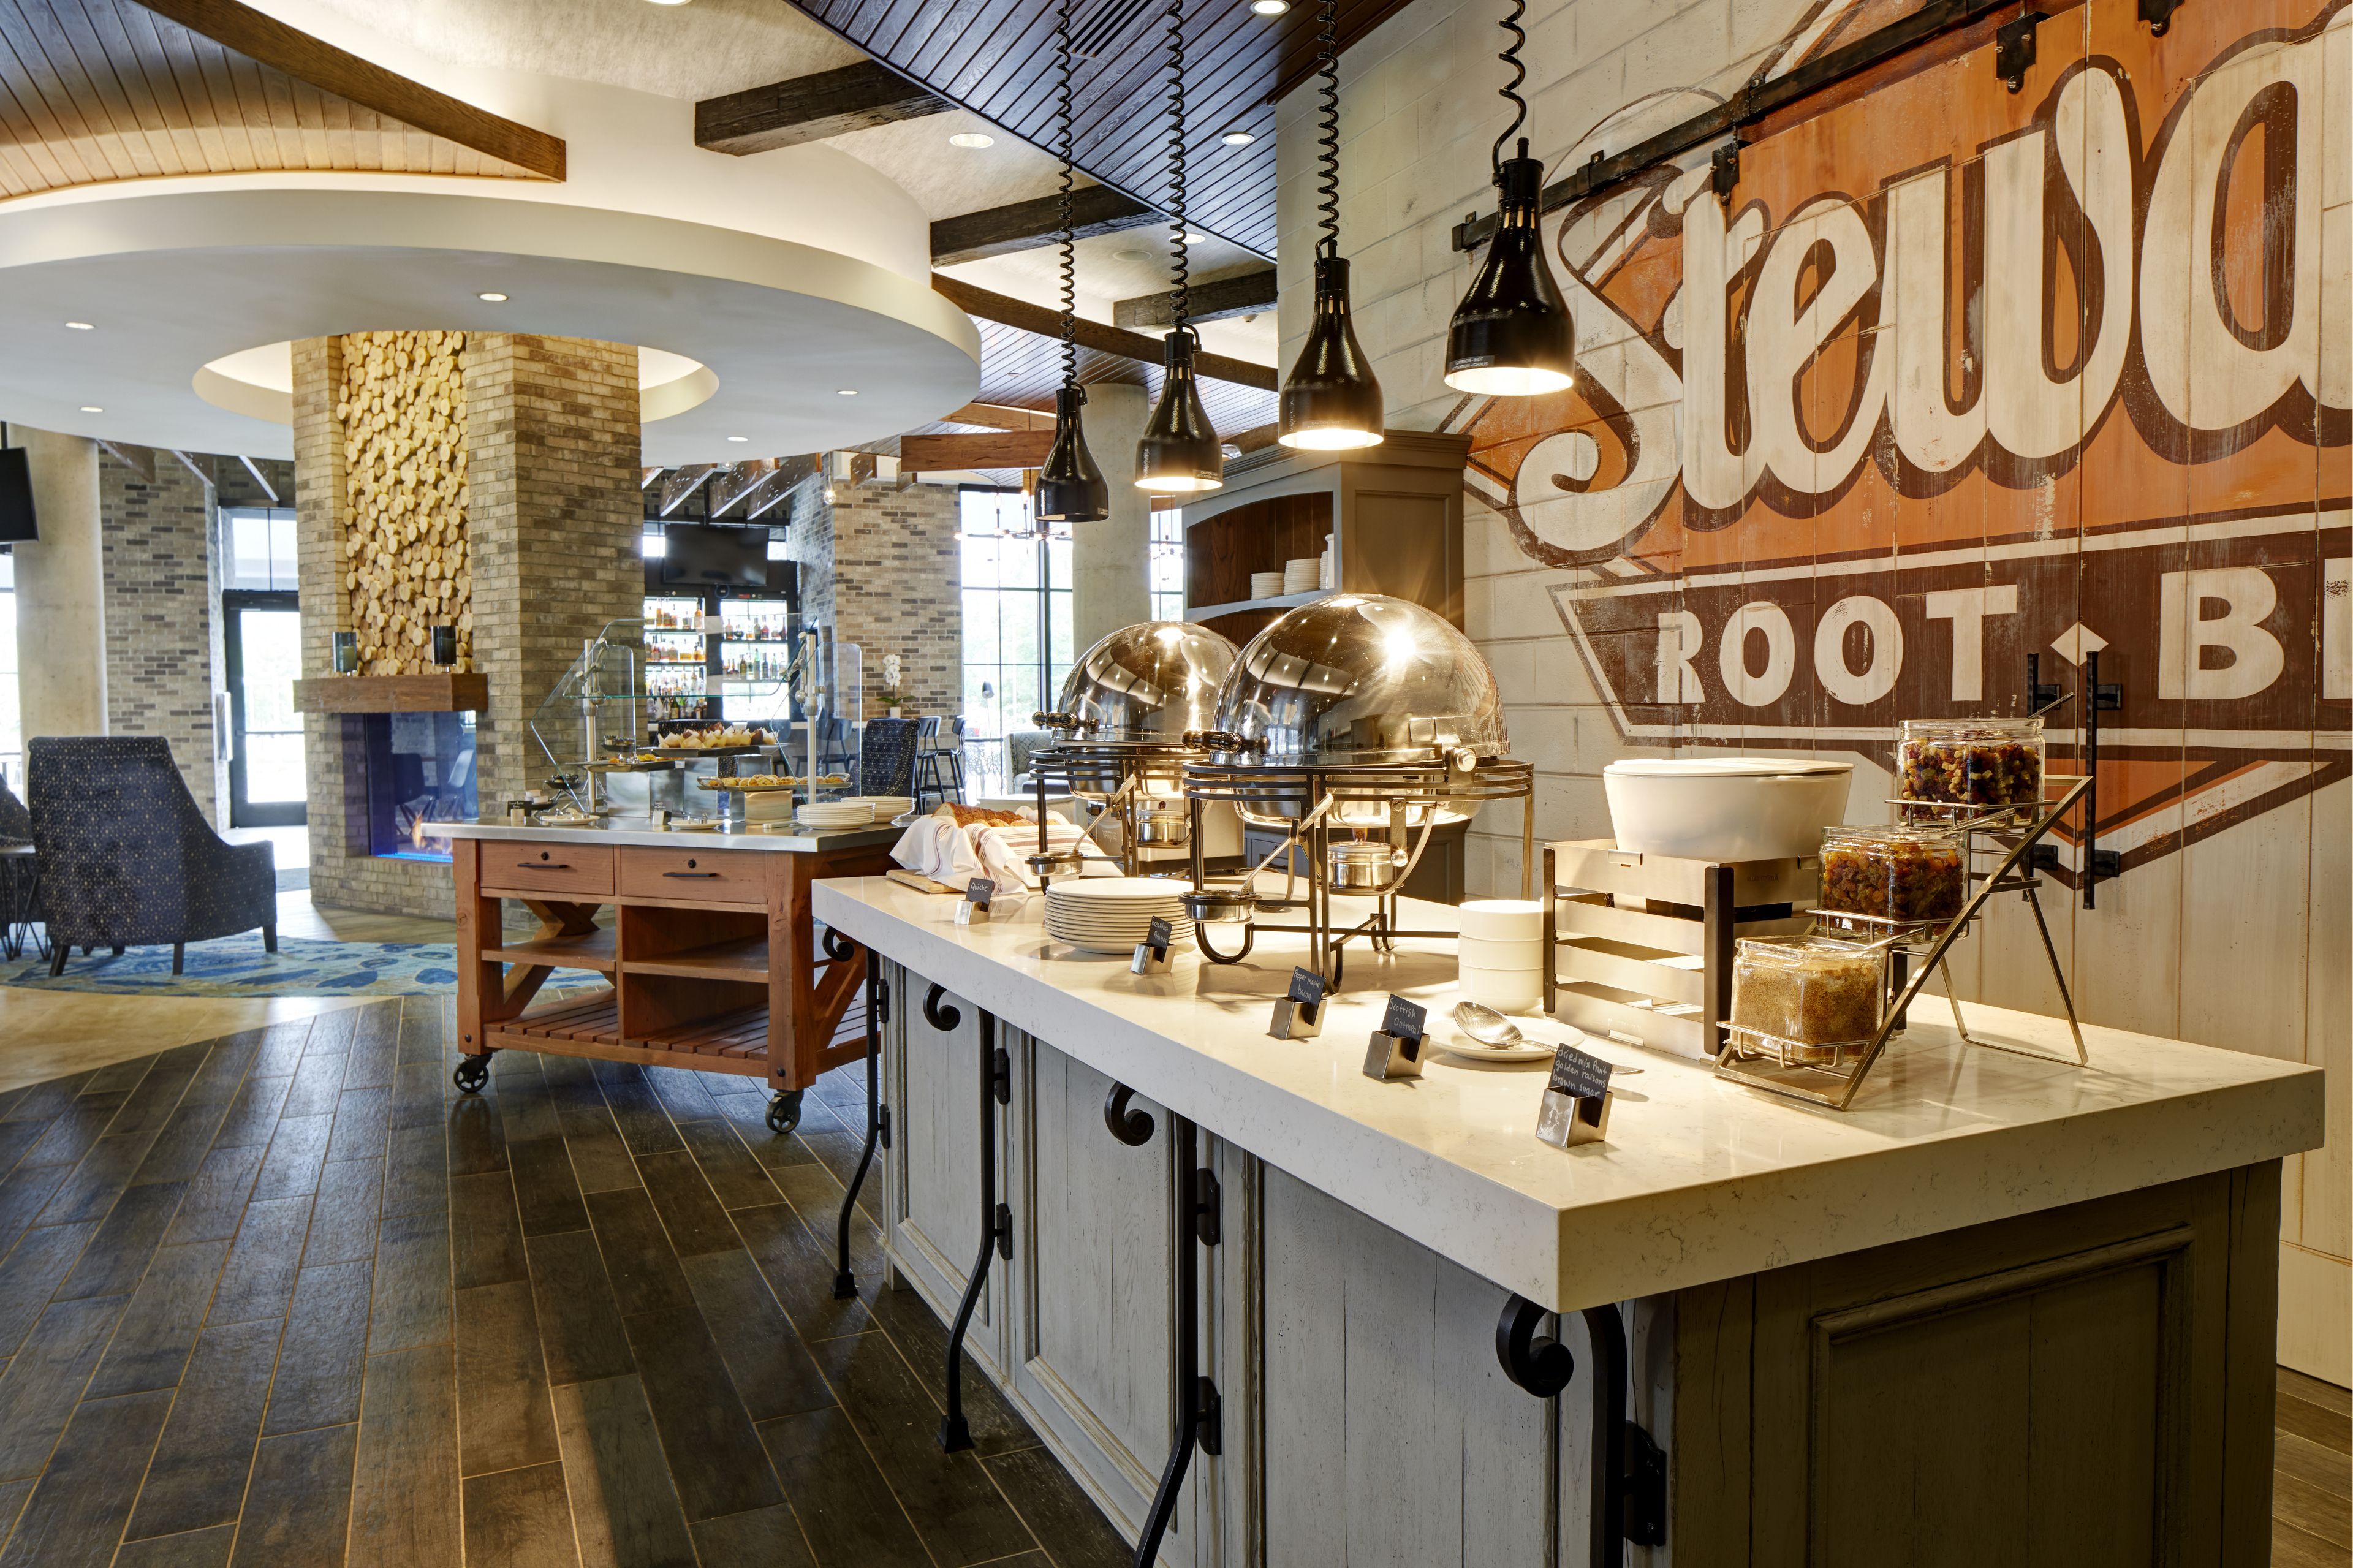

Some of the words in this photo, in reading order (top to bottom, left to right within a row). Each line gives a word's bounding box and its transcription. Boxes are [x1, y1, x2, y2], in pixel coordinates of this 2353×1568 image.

[1657, 584, 2017, 707] ROOT
[971, 882, 988, 892] Quiche
[1294, 969, 1306, 982] Pepper
[1297, 983, 1311, 1000] bacon
[1389, 997, 1415, 1019] Scottish
[1394, 1017, 1420, 1035] Oatmeal
[1555, 1059, 1578, 1076] golden
[1558, 1045, 1578, 1063] dried
[1578, 1058, 1590, 1070] mix
[1593, 1060, 1607, 1075] fruit
[1552, 1069, 1576, 1090] brown
[1579, 1083, 1601, 1098] sugar
